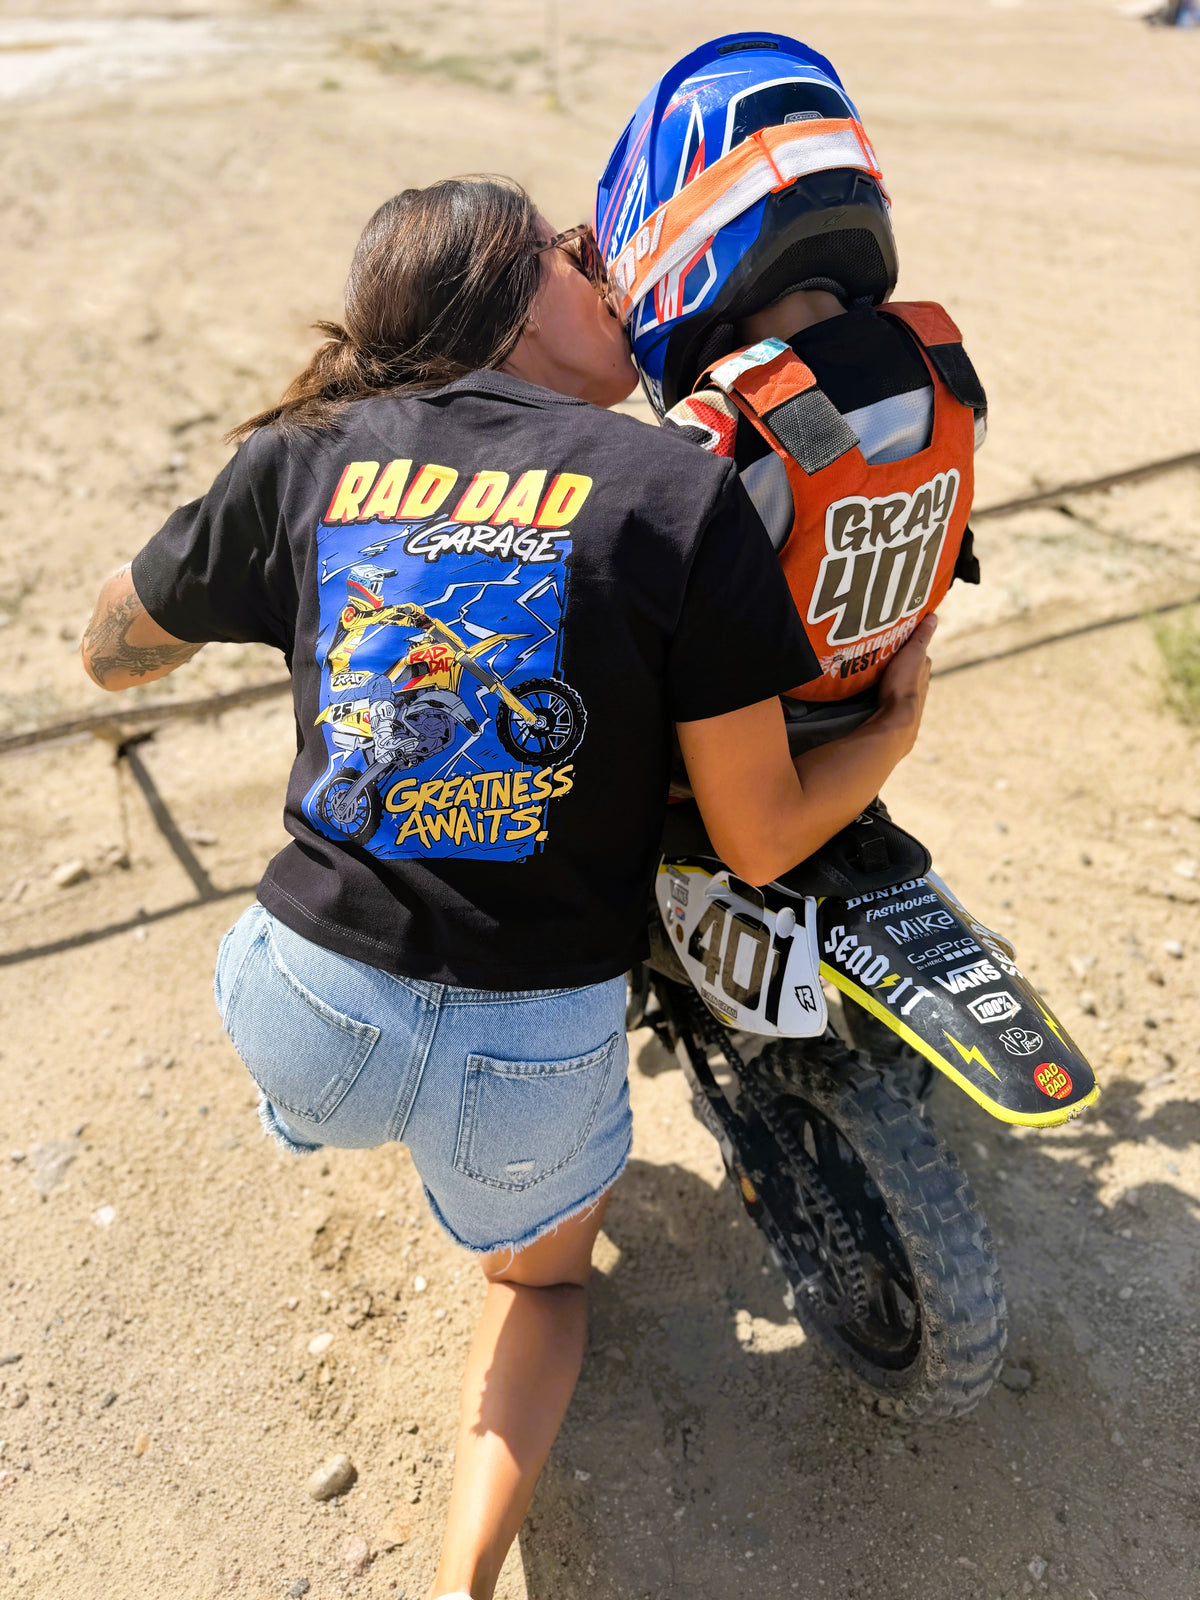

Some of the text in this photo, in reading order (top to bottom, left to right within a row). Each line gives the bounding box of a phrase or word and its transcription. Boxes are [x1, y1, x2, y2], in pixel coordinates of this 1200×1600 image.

[324, 459, 593, 528] RAD DAD
[831, 474, 957, 552] GRAY
[406, 521, 570, 562] GARAGE
[813, 522, 945, 641] 401
[409, 647, 448, 664] RAD
[385, 764, 576, 813] GREATNESS
[845, 877, 928, 910] DUNLOP
[866, 893, 939, 923] FASTHOUSE
[906, 937, 975, 964] GoPro
[932, 958, 1002, 995] VANS
[977, 995, 1012, 1018] 100%
[1037, 1062, 1059, 1087] RAD
[1045, 1073, 1067, 1097] DAD
